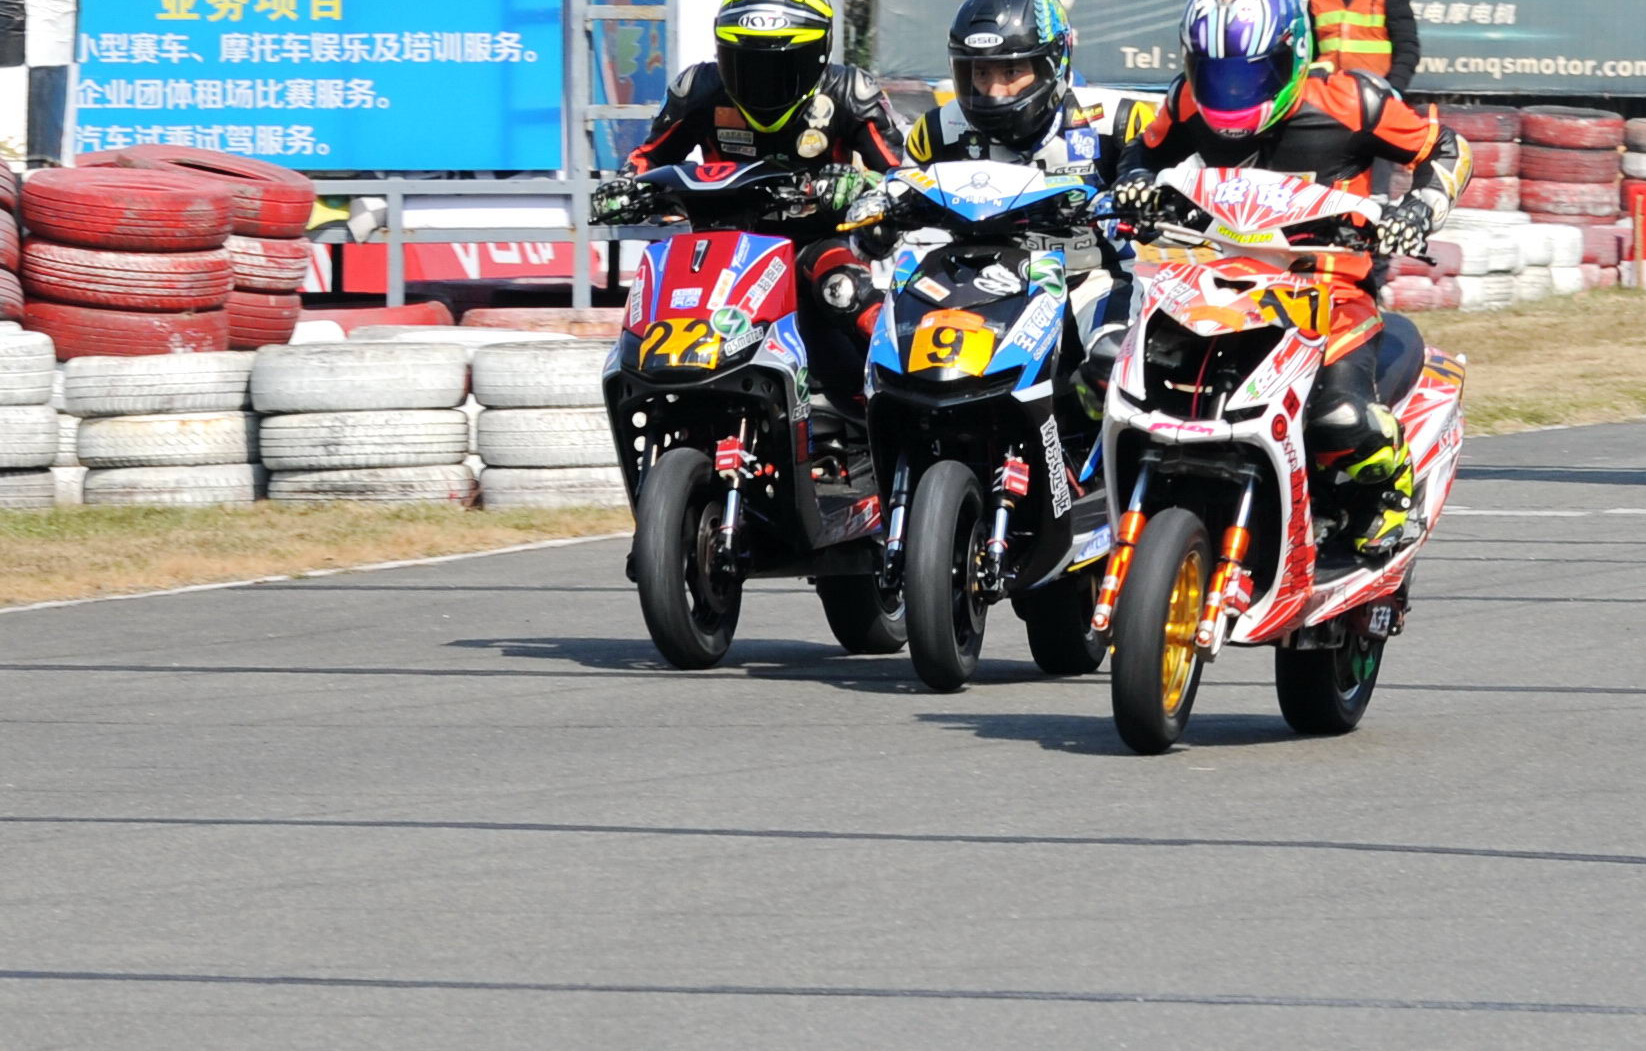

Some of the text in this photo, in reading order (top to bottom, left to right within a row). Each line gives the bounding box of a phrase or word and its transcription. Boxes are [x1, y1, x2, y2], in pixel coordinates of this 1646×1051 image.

[743, 14, 783, 28] KYT
[77, 78, 392, 110] 企业团体租场比赛服务。
[639, 319, 716, 371] 22
[926, 325, 965, 365] 9
